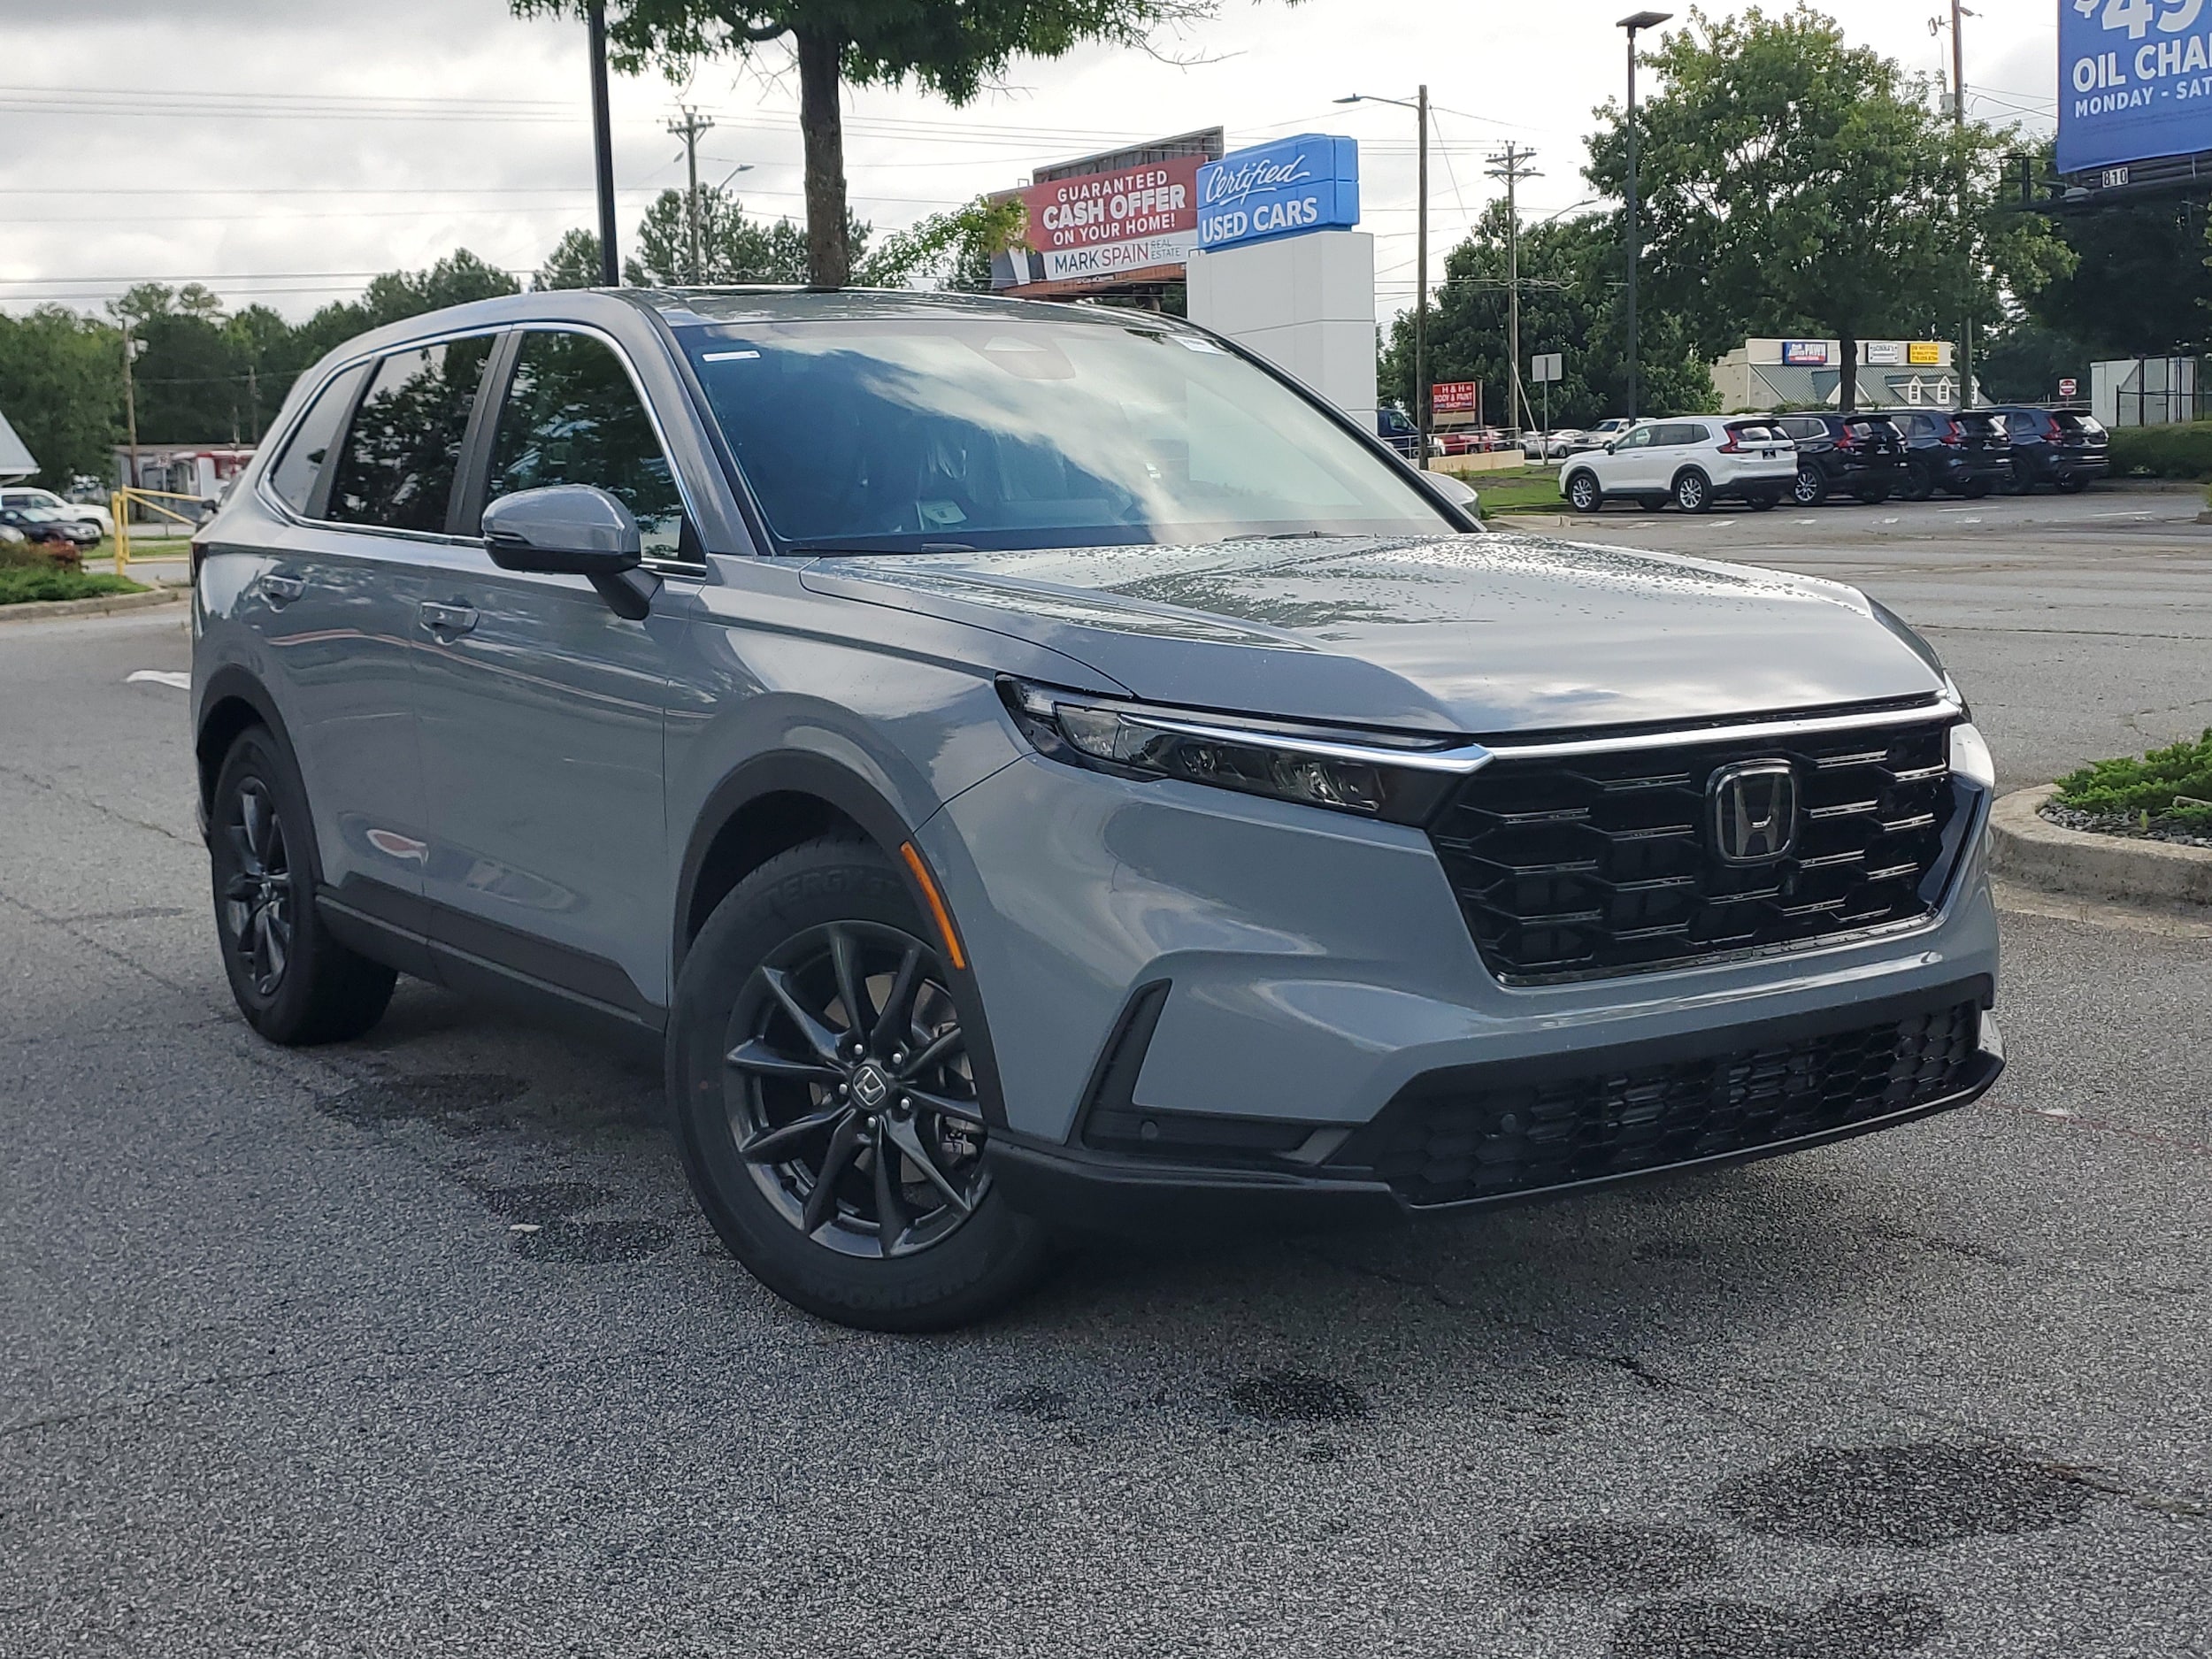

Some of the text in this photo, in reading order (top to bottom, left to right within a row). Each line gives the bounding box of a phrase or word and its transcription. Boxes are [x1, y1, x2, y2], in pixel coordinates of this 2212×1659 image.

[2072, 32, 2212, 93] OIL CHA
[2075, 87, 2154, 119] MONDAY
[1057, 170, 1168, 203] GUARANTEED
[1206, 154, 1310, 206] Certified
[1042, 184, 1187, 230] CASH OFFER
[1202, 196, 1317, 243] USED CARS
[1053, 212, 1176, 246] ON YOUR HOME!
[1150, 239, 1172, 250] REAL
[1055, 242, 1149, 274] MARK SPAIN
[1151, 247, 1181, 260] ESTATE
